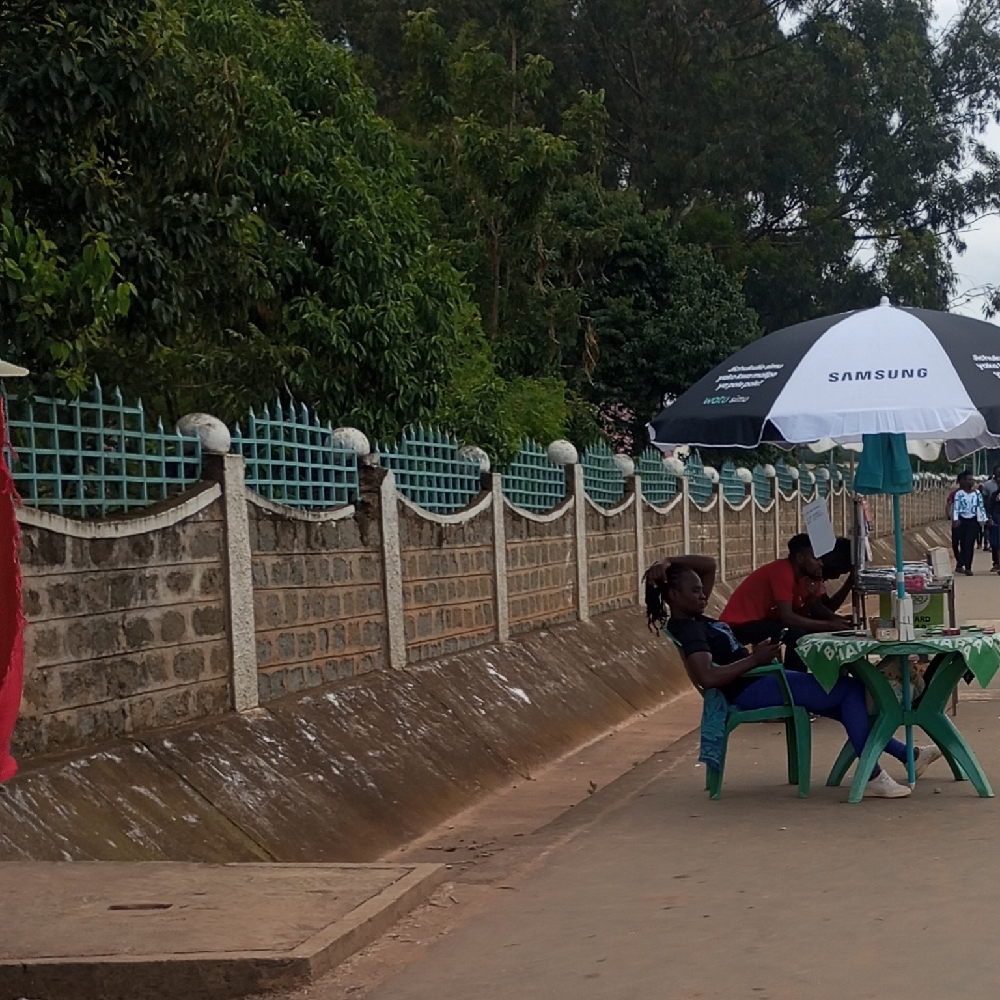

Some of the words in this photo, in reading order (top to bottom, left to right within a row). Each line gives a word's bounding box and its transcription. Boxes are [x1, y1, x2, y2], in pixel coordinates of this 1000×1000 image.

[828, 367, 928, 383] SAMSUNG
[703, 396, 730, 405] watu
[729, 395, 750, 403] simu
